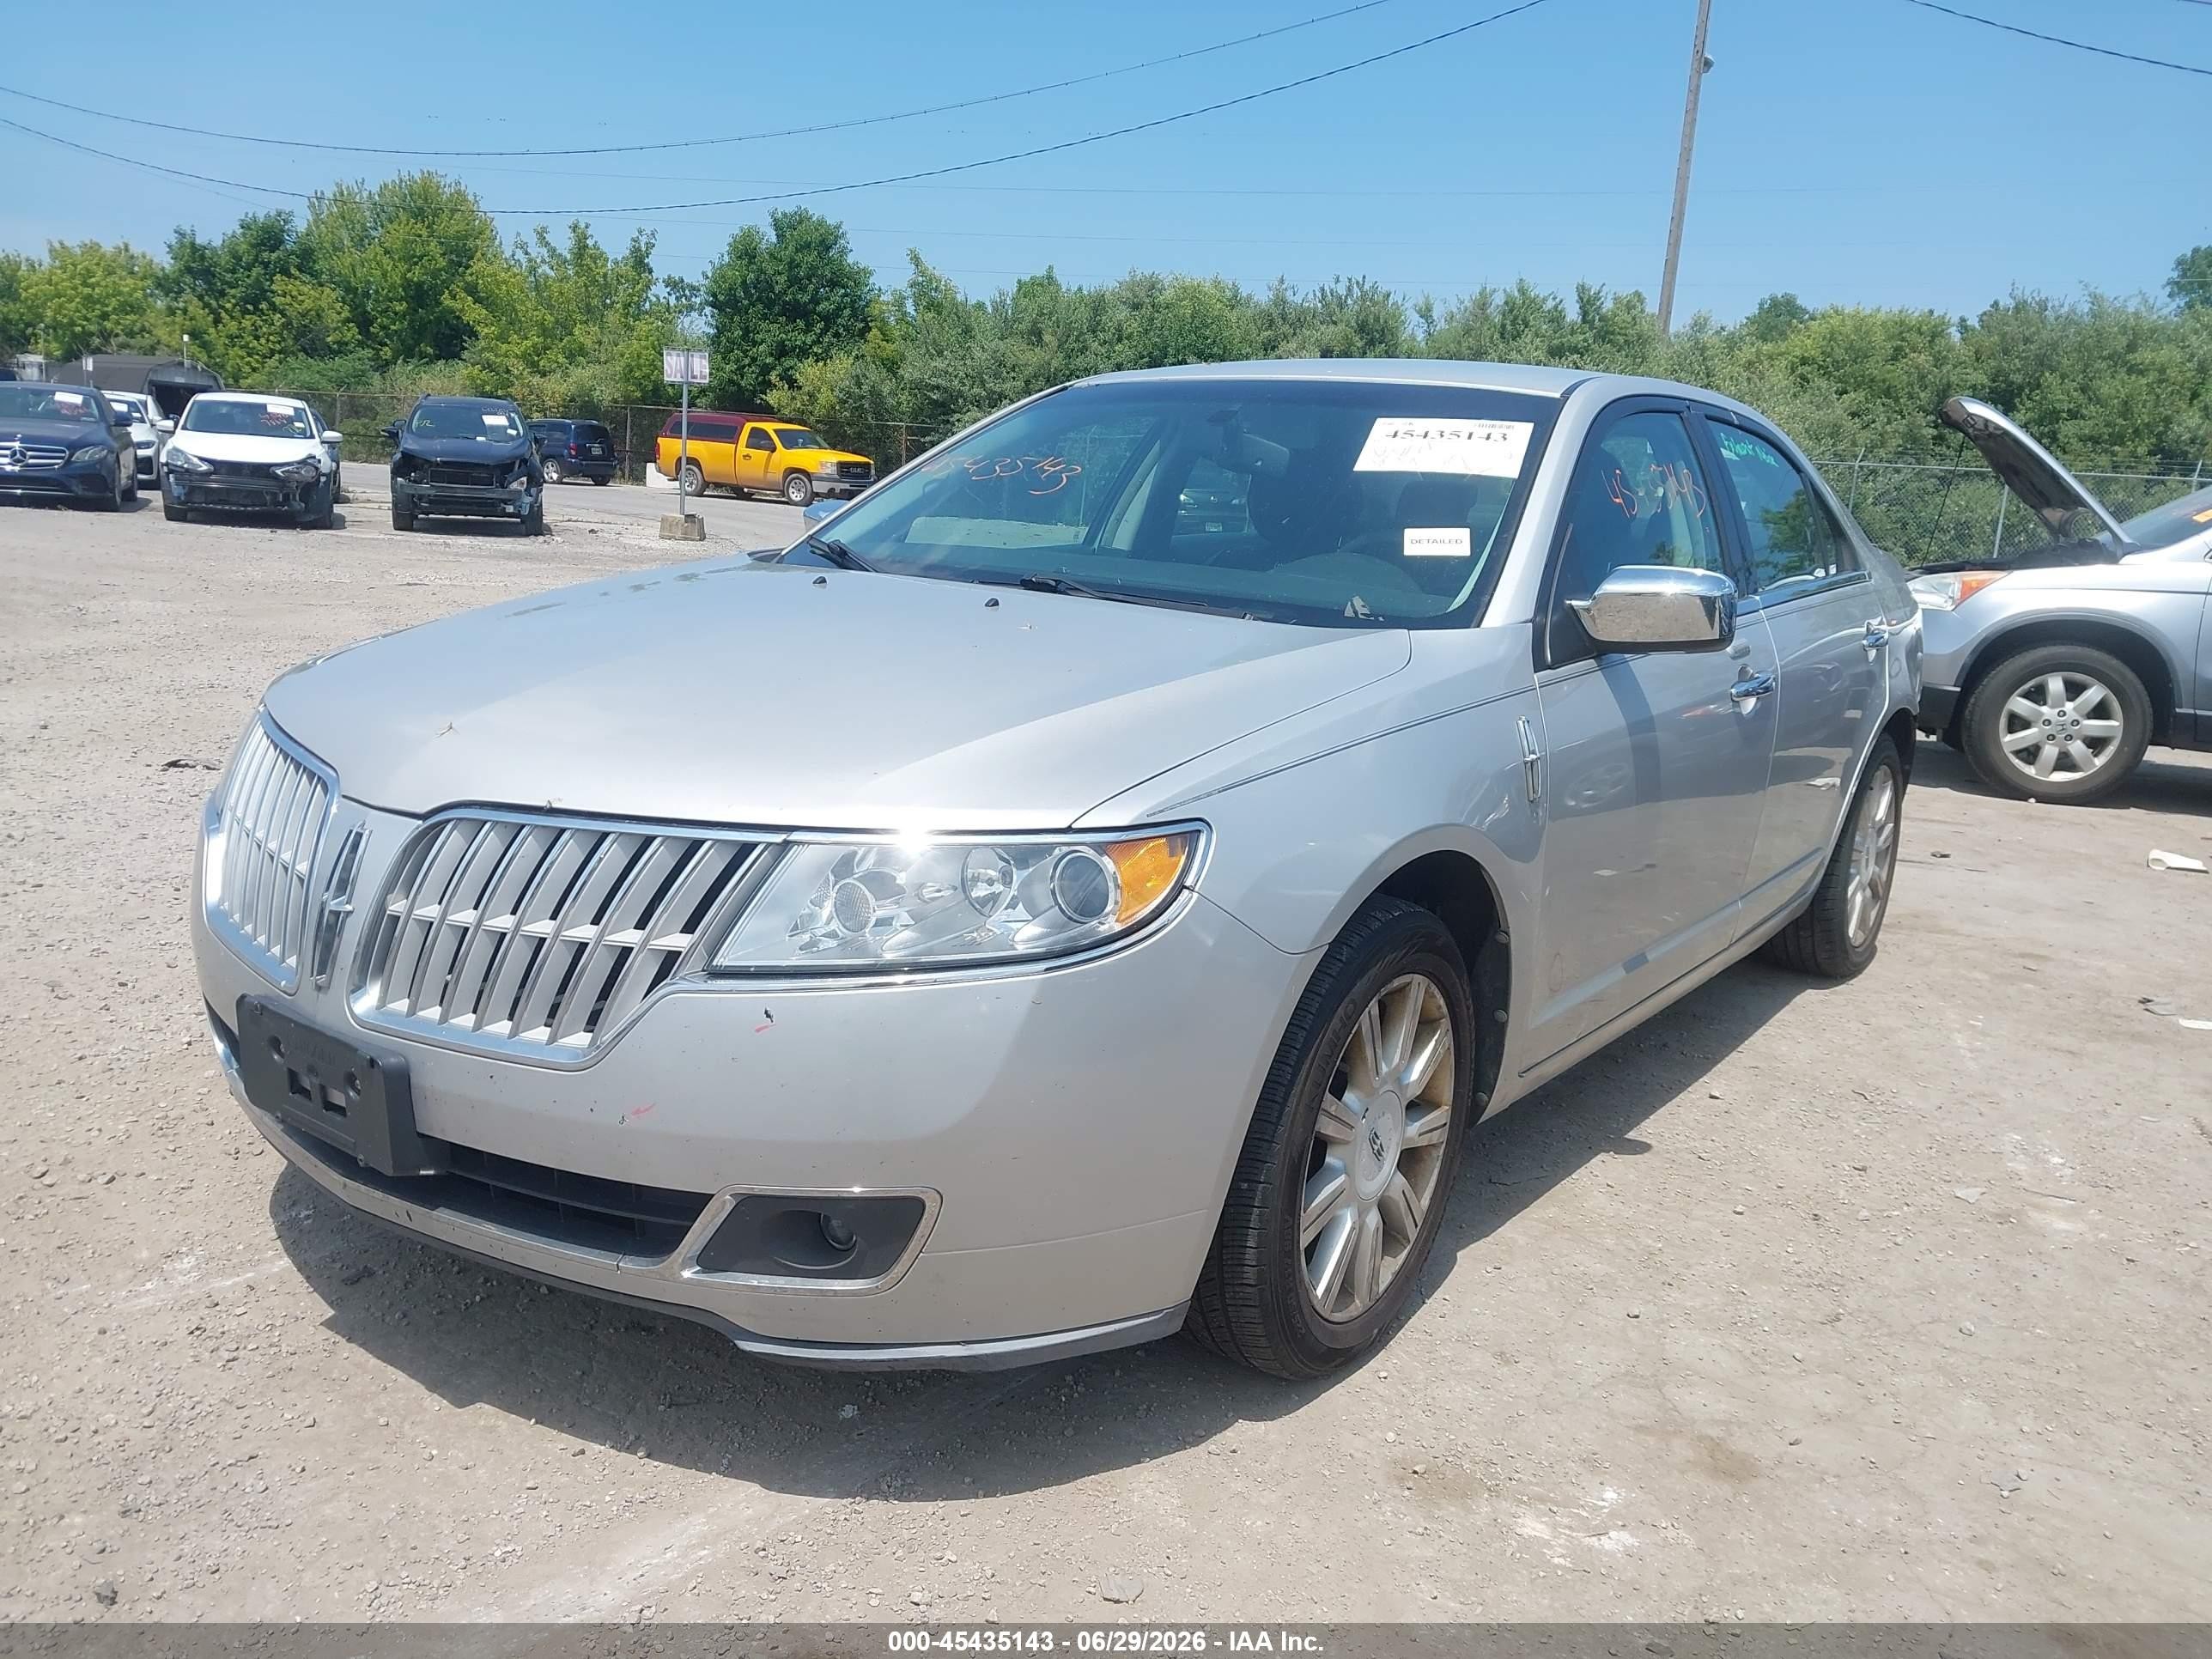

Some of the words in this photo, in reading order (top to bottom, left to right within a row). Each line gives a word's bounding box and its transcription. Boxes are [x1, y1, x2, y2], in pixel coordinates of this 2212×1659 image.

[665, 352, 708, 380] SALE
[1384, 430, 1508, 442] 45435143
[1601, 462, 1706, 519] 455143
